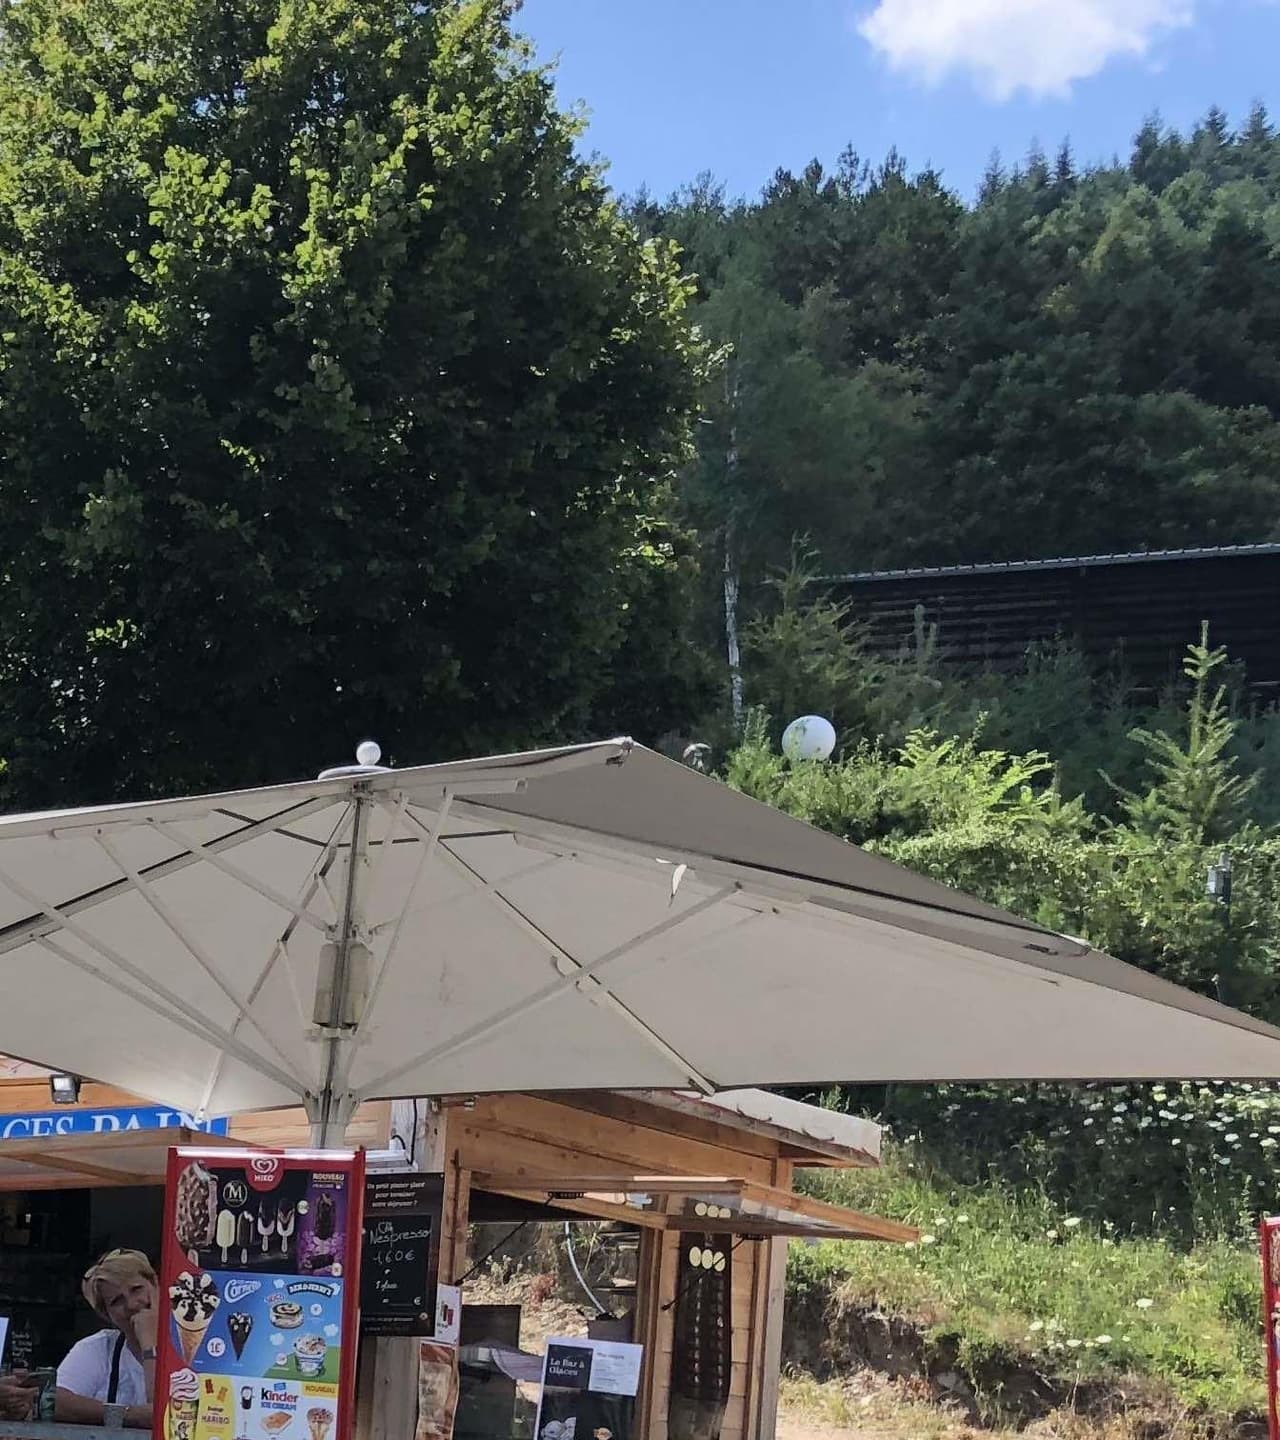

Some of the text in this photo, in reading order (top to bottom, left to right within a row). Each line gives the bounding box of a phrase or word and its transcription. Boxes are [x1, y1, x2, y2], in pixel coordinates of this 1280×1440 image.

[370, 1227, 431, 1247] Nespresso
[550, 1358, 561, 1366] Le
[562, 1359, 578, 1368] Bar
